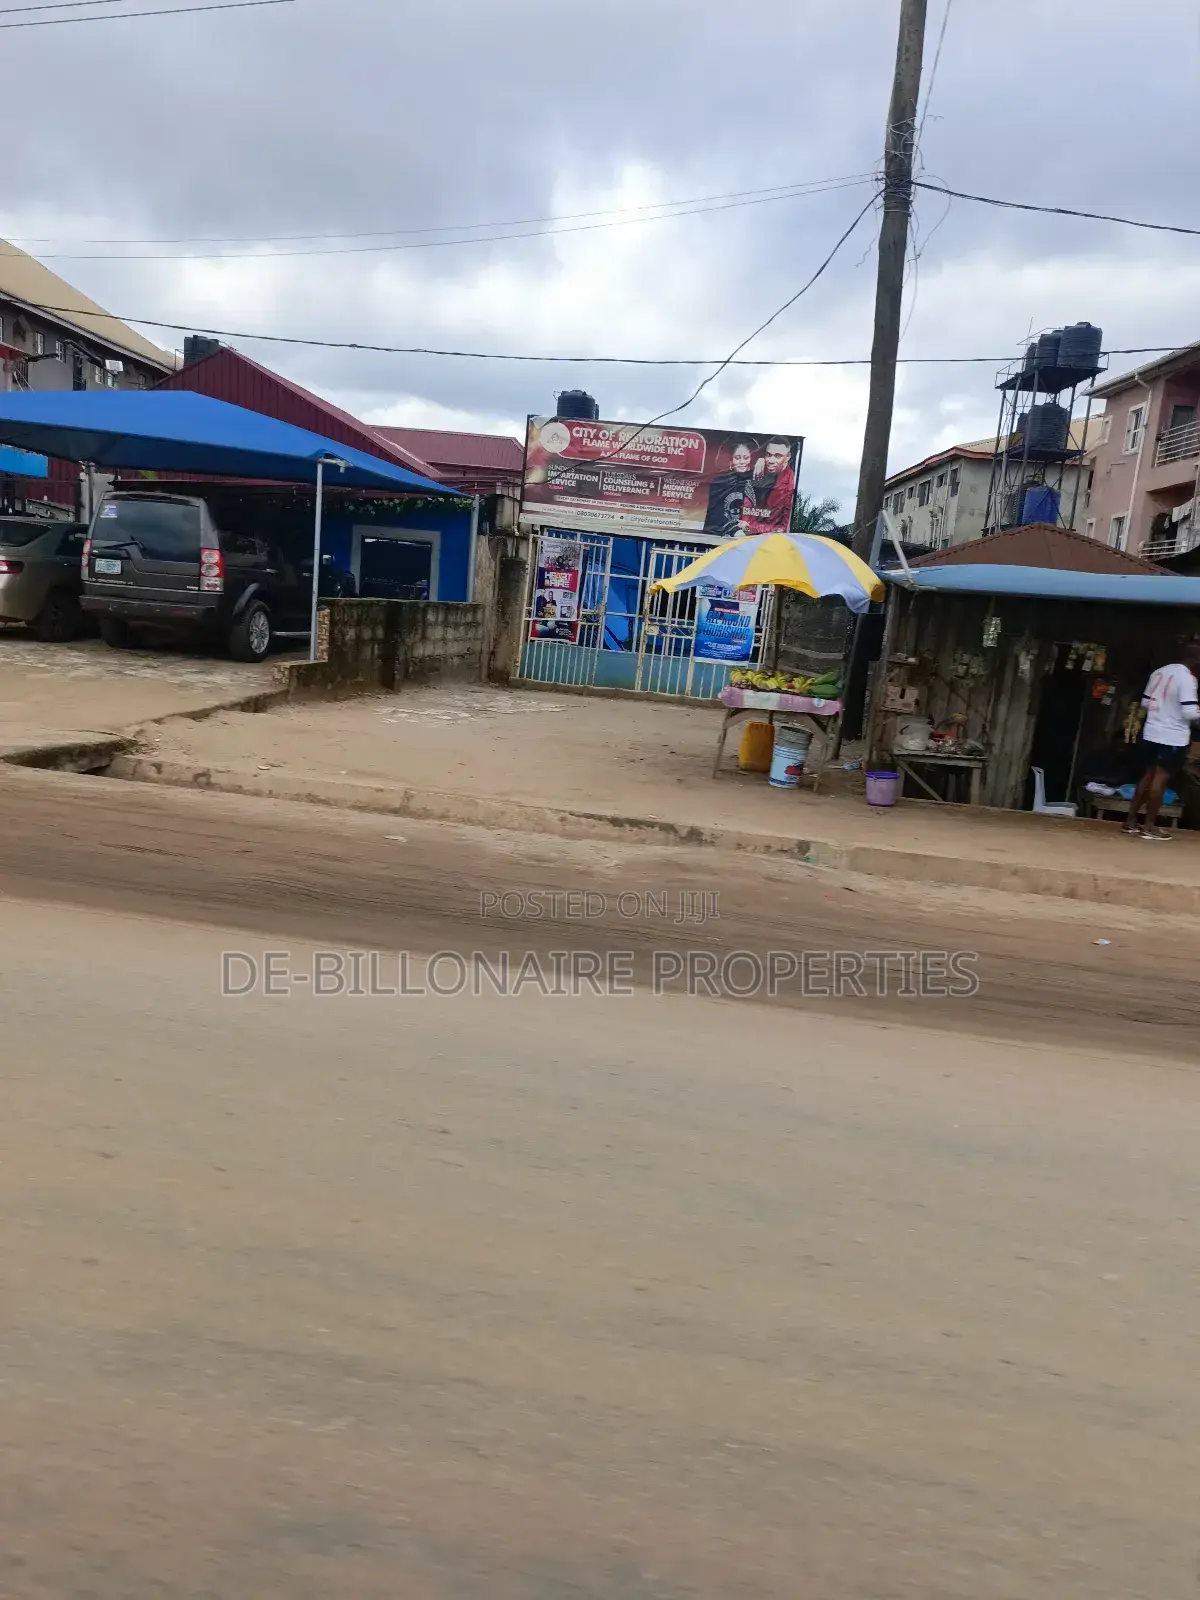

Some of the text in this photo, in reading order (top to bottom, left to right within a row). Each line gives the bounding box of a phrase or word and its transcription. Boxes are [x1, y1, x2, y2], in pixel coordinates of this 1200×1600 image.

[572, 426, 699, 449] CITY OF RESTORATION
[582, 438, 610, 449] FLAME
[612, 441, 666, 455] WORLDWIDE
[651, 456, 669, 464] GOD
[604, 470, 637, 481] TUESDAYS
[547, 477, 577, 487] SERVICE
[603, 476, 648, 488] COUNSELING
[602, 483, 651, 496] DELIVERANCE
[662, 483, 696, 493] MIDWEEK
[661, 490, 693, 500] SERVICE
